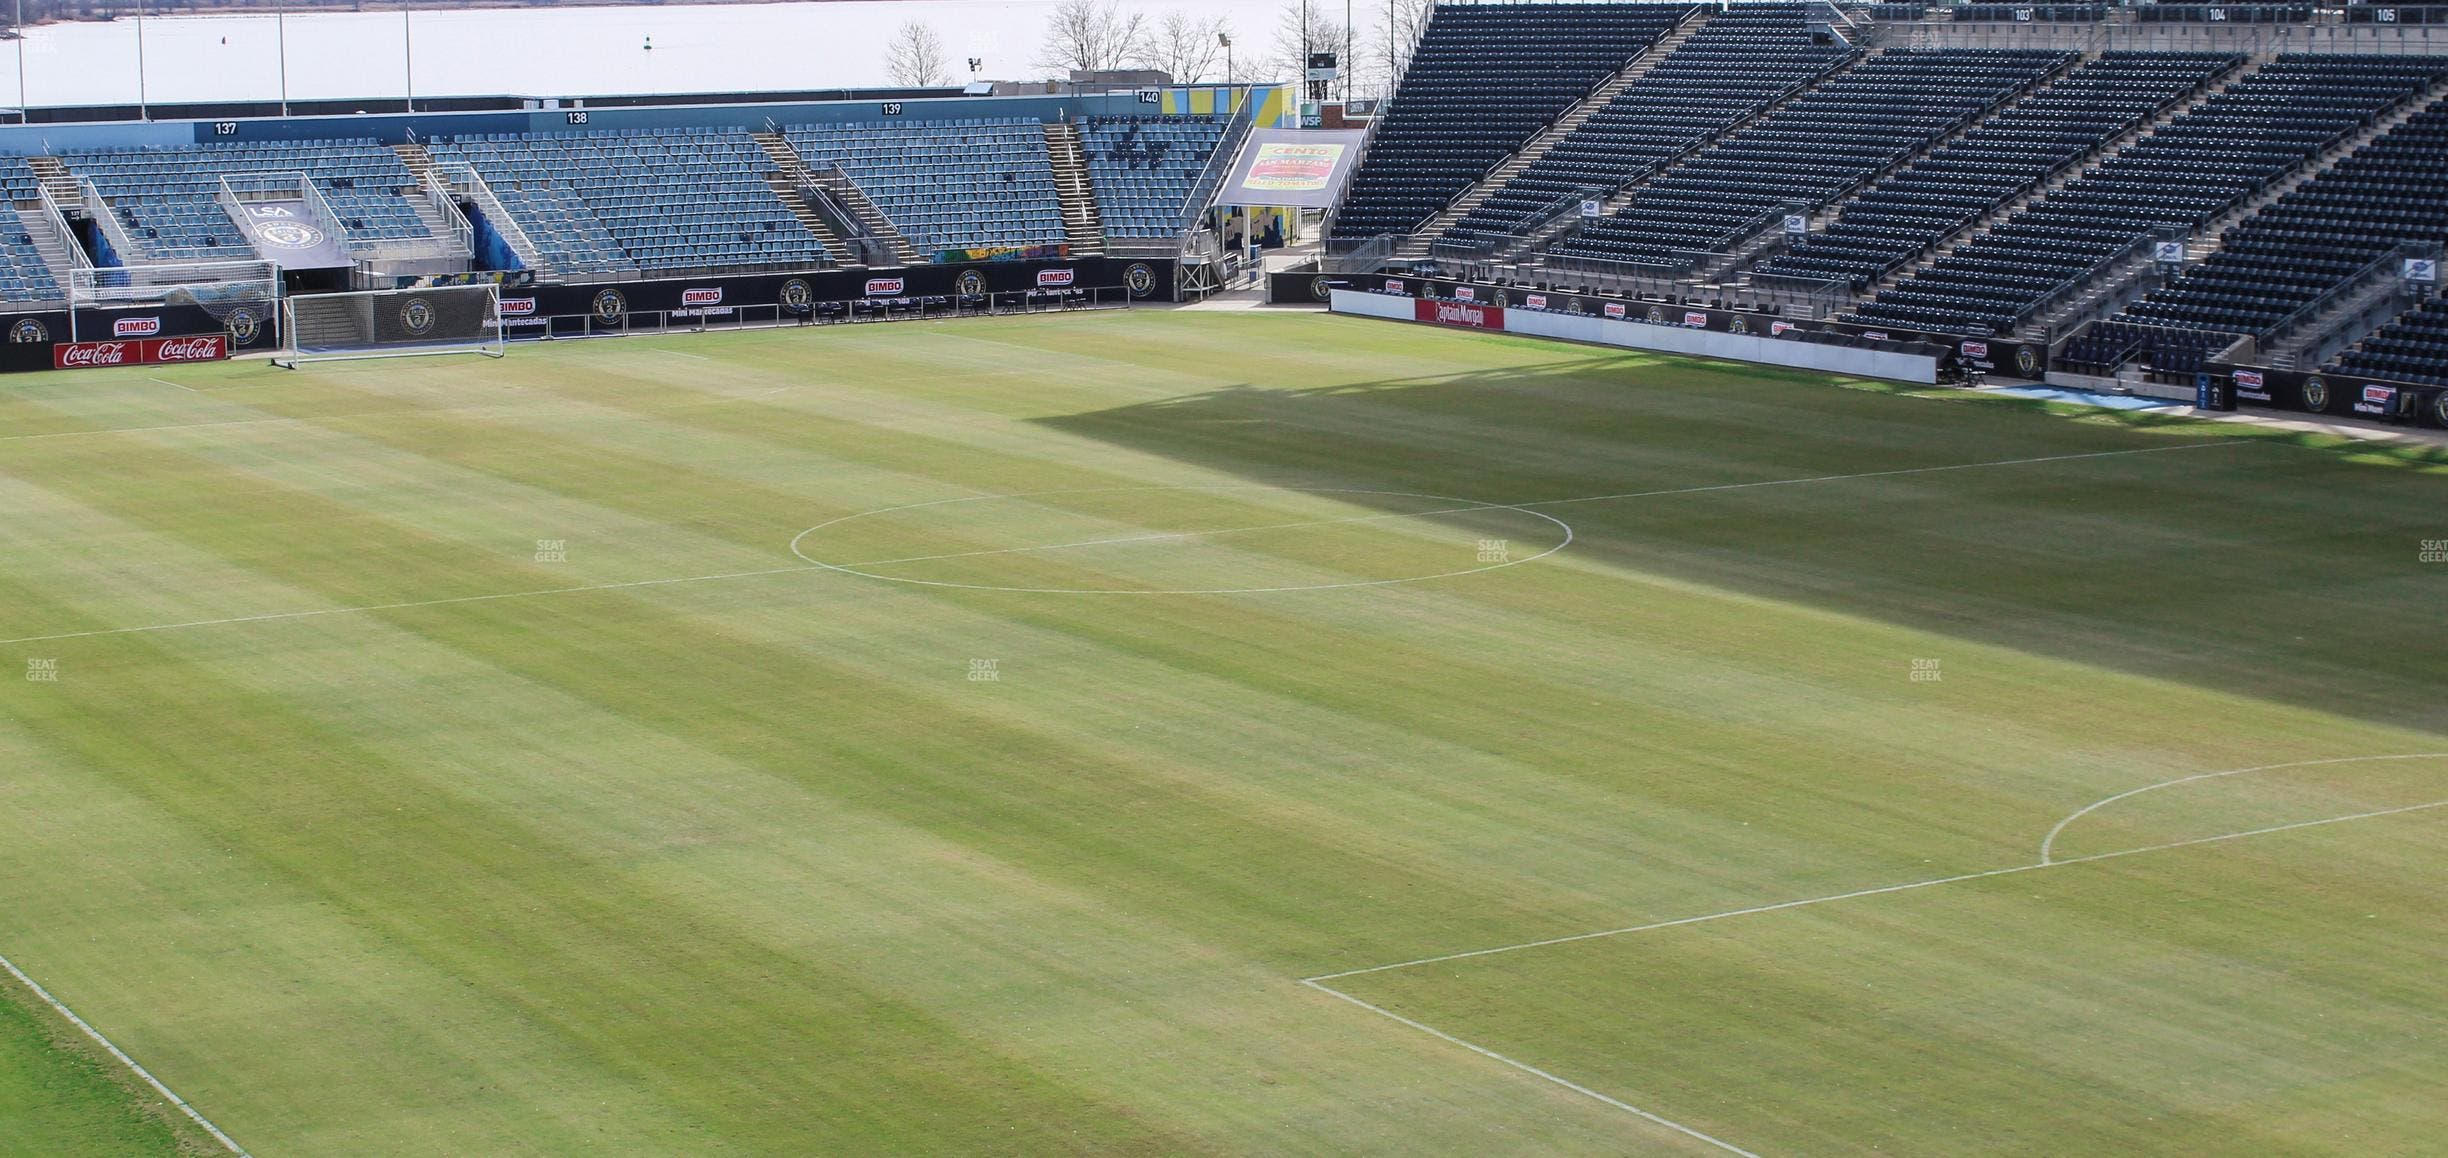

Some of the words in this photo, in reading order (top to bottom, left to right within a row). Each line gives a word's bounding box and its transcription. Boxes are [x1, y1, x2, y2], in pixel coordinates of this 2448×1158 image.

[2016, 9, 2030, 21] 103
[2210, 8, 2226, 21] 104
[2377, 8, 2395, 21] 105
[1140, 92, 1158, 103] 140
[883, 103, 901, 115] 139
[568, 112, 588, 124] 138
[215, 122, 237, 135] 137
[1040, 272, 1072, 282] BIMBO
[868, 281, 902, 292] BIMBO
[685, 291, 720, 302] BIMBO
[499, 301, 533, 312] BIMBO
[671, 307, 688, 318] Mini
[1436, 301, 1460, 323] Captain
[1460, 304, 1484, 326] Morgan
[117, 320, 157, 333] BIMBO
[63, 342, 126, 367] Coca-Cola
